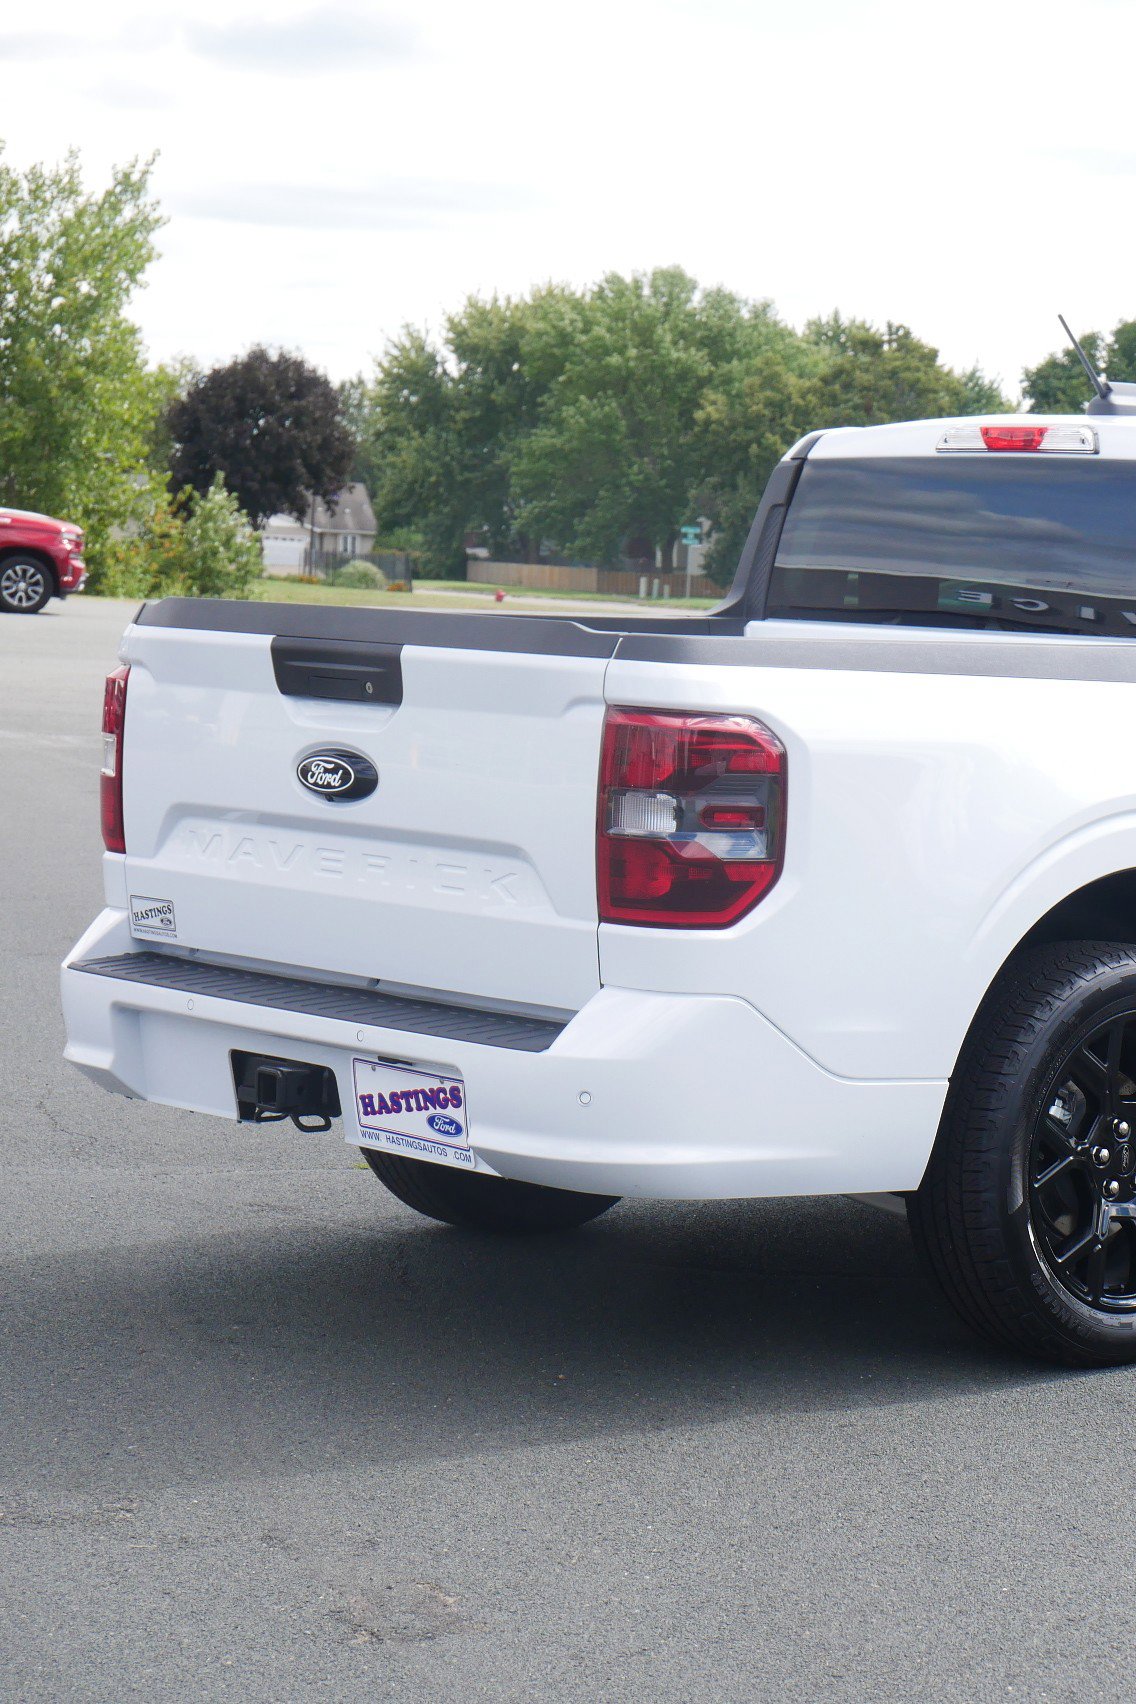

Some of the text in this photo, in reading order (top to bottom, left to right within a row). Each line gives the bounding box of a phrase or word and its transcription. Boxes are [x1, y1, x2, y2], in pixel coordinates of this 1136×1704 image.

[307, 760, 343, 787] Ford
[186, 829, 519, 904] MAVERICK
[133, 904, 172, 922] HASTINGS
[359, 1085, 463, 1117] HASTINGS
[433, 1115, 456, 1134] Ford
[385, 1134, 448, 1158] HASTINGSAUTOS
